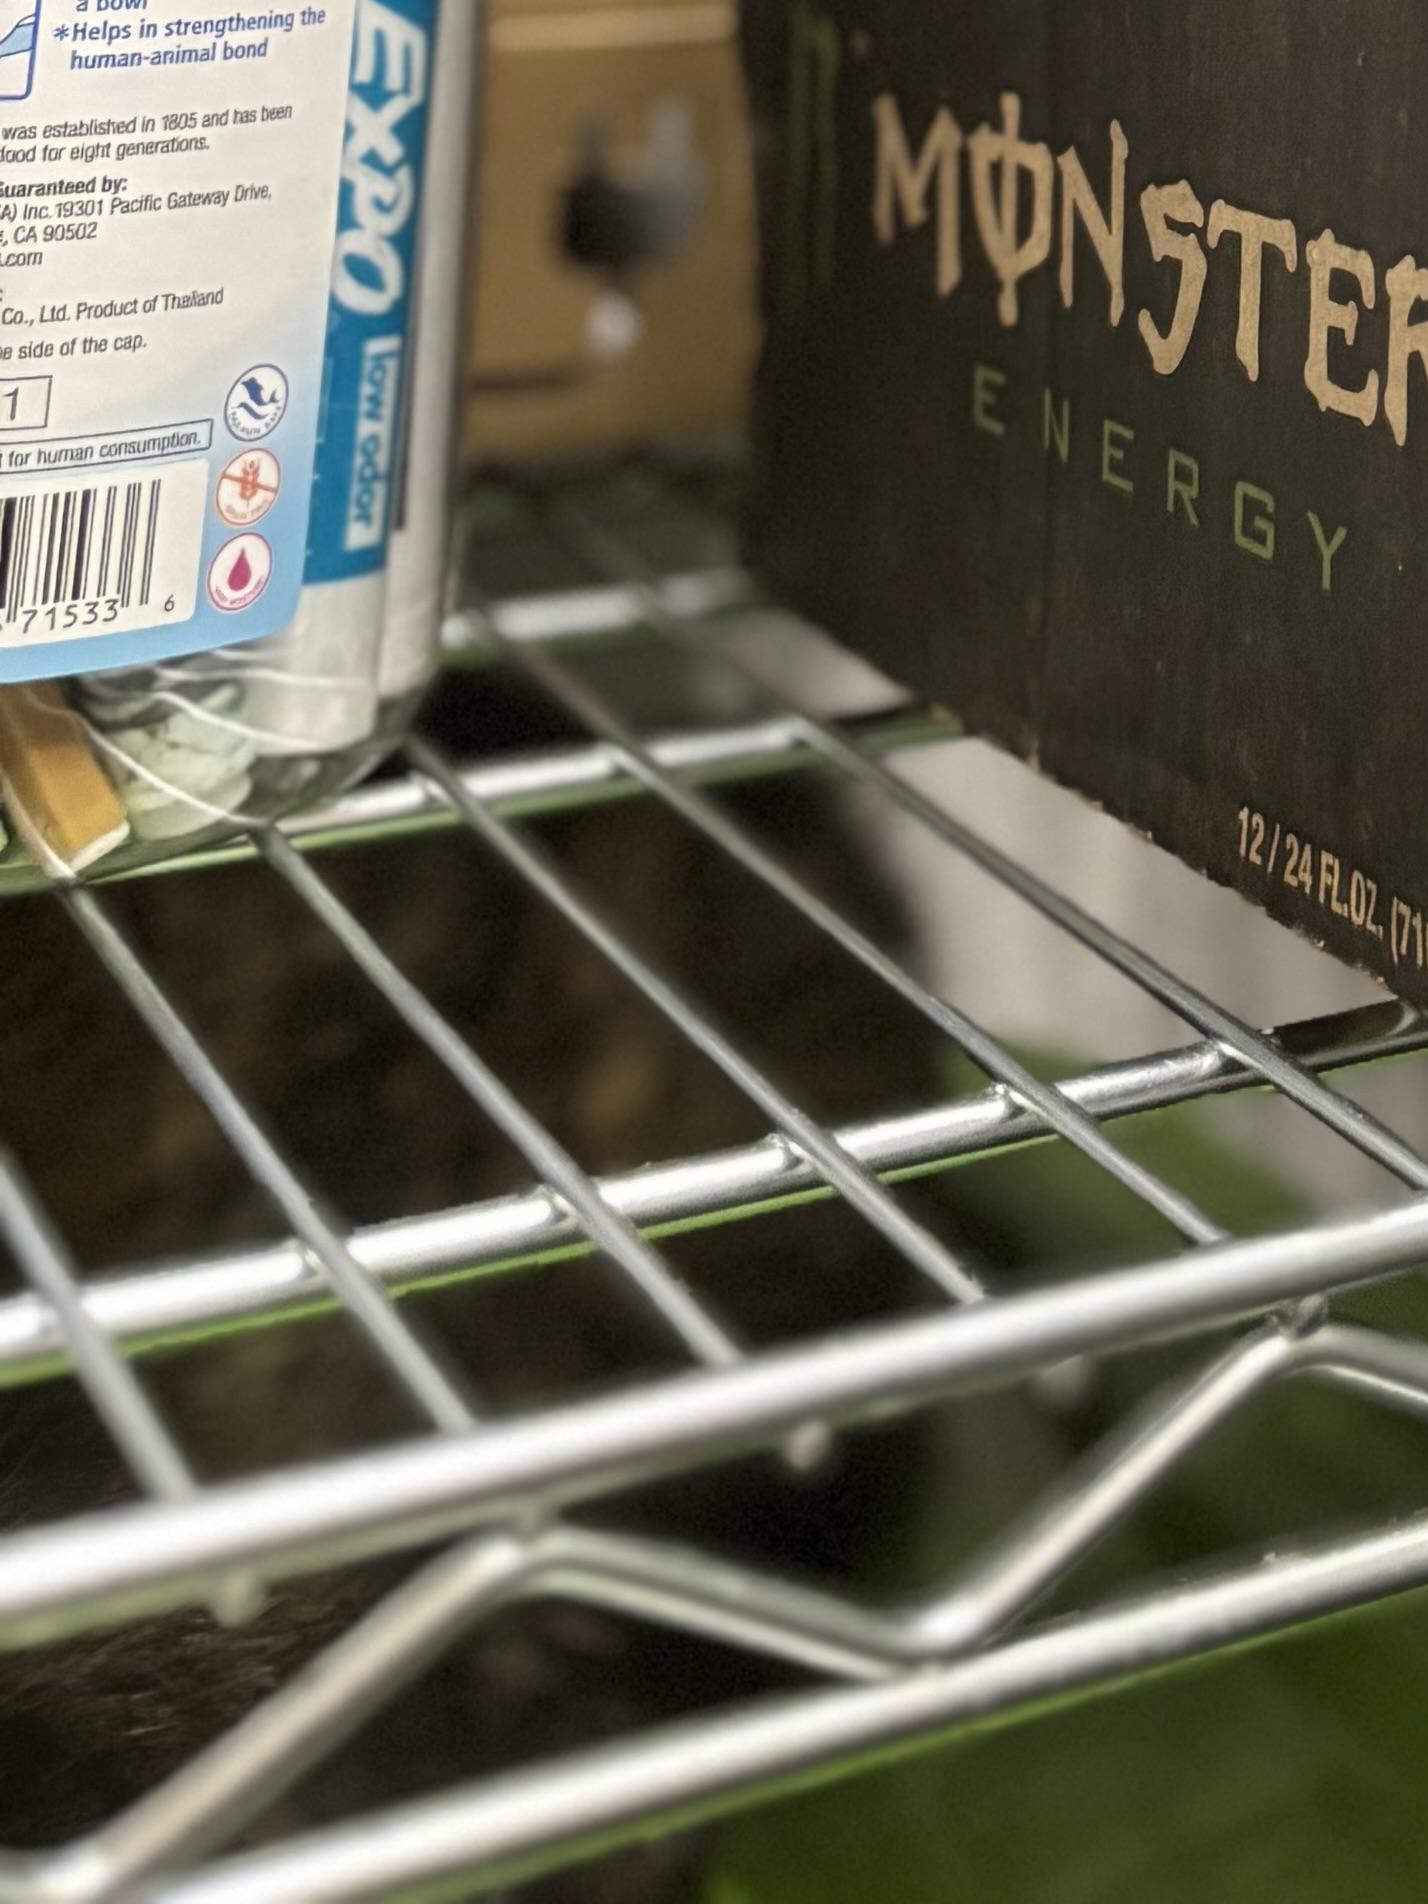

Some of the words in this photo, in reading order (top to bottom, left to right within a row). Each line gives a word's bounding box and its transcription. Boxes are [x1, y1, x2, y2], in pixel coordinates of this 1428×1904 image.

[139, 18, 157, 40] in
[165, 10, 294, 39] strengthening
[301, 6, 326, 25] the
[70, 41, 215, 70] human-animal
[223, 38, 268, 60] bond
[2, 123, 37, 140] was
[43, 117, 136, 138] established
[141, 116, 155, 133] in
[162, 113, 197, 131] 1805
[202, 109, 229, 128] and
[233, 107, 257, 125] has
[261, 104, 293, 122] been
[42, 144, 65, 163] for
[70, 142, 111, 163] eight
[116, 136, 210, 160] generations.
[23, 203, 52, 221] Inc.
[56, 199, 103, 219] 19301
[110, 194, 162, 216] Pacific
[167, 190, 229, 211] Gateway
[234, 183, 272, 203] Drive,
[101, 175, 128, 195] by:
[14, 224, 38, 244] CA
[43, 222, 98, 242] 90502
[2, 307, 34, 327] Co.,
[39, 303, 71, 323] Ltd.
[76, 299, 138, 321] Product
[143, 295, 159, 313] of
[162, 287, 224, 312] Thailand
[18, 341, 54, 359] side
[60, 337, 78, 356] of
[82, 336, 108, 354] the
[113, 334, 147, 352] cap.
[9, 449, 32, 468] for
[37, 446, 94, 465] human
[99, 431, 201, 459] consumption.
[352, 435, 392, 526] odor
[973, 364, 1347, 591] ENERGY
[22, 599, 119, 634] 71533
[164, 594, 175, 612] 6
[1238, 805, 1265, 866] 12
[1283, 832, 1313, 895] 24
